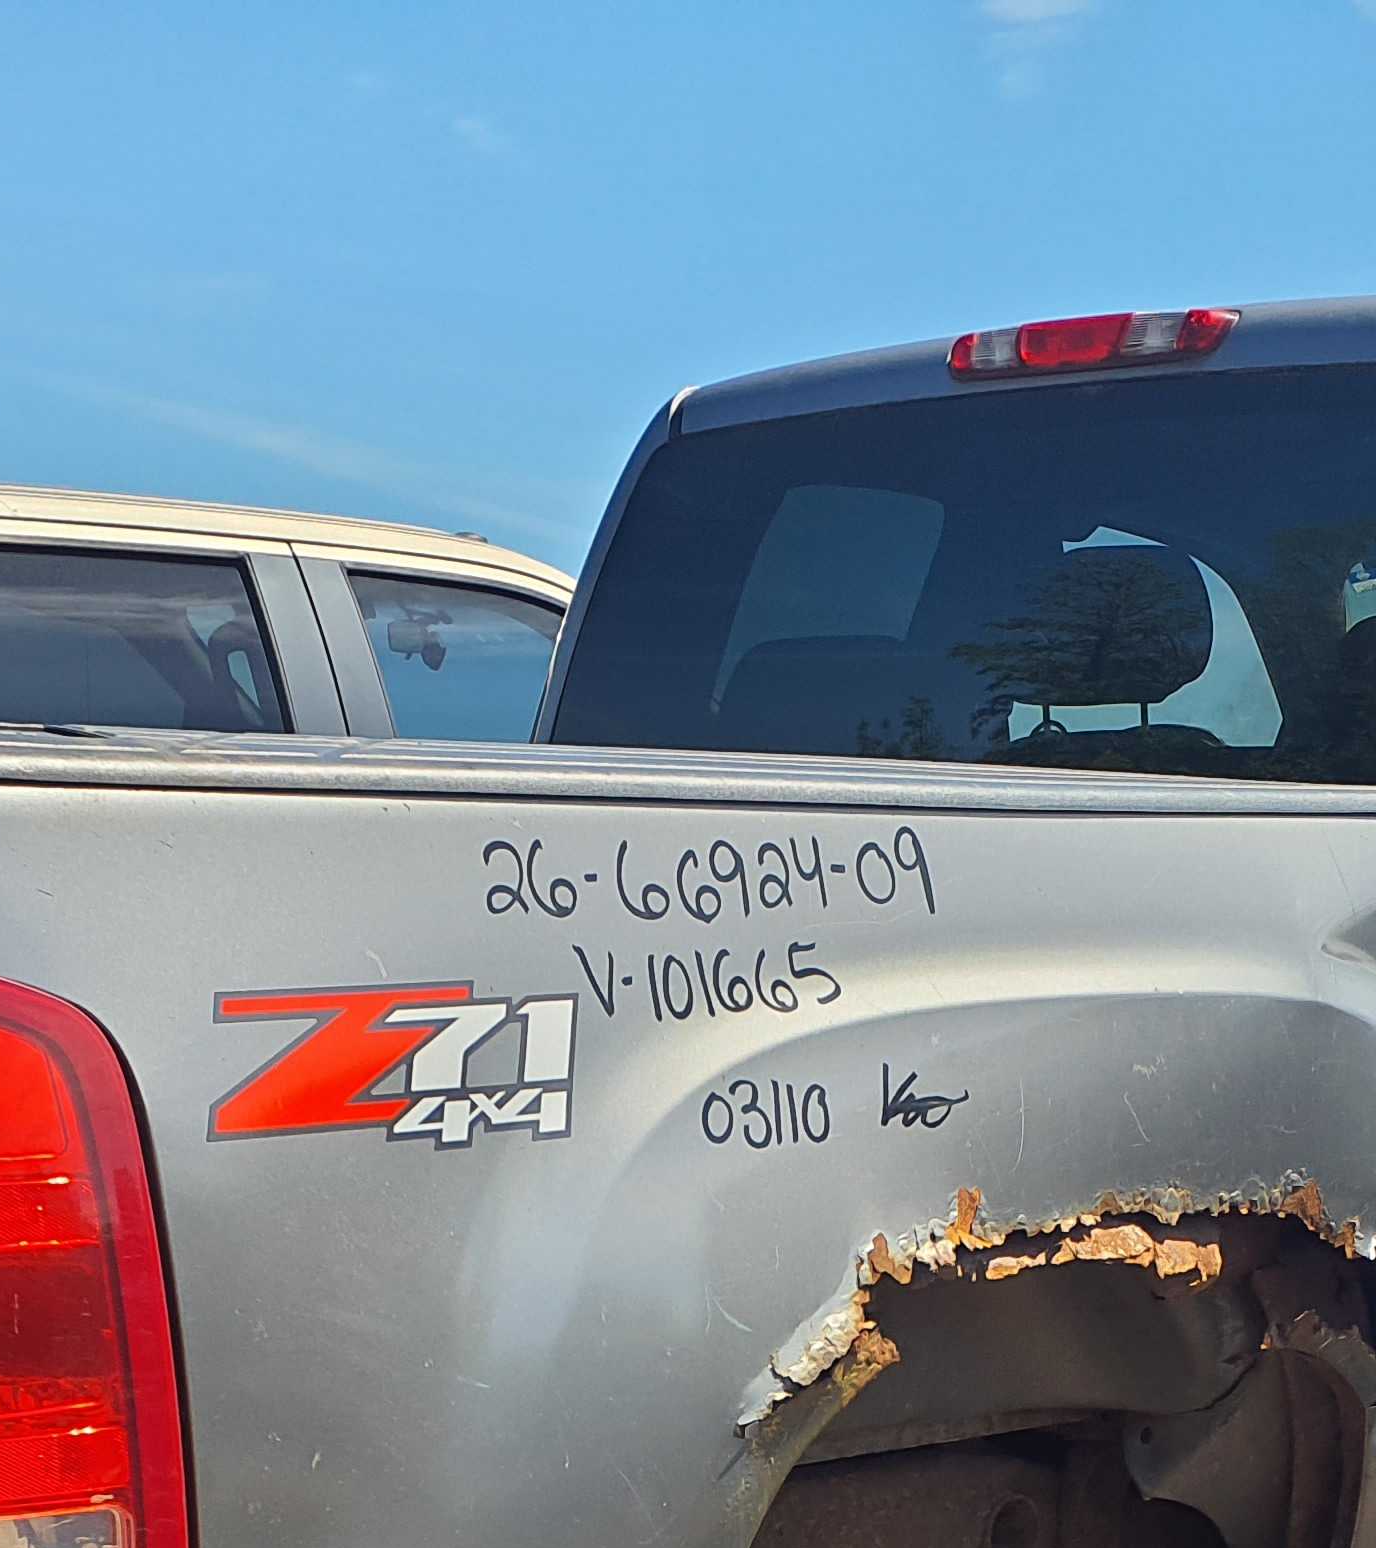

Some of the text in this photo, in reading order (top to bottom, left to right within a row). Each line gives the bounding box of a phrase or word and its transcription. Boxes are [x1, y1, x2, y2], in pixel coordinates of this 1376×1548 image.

[482, 826, 936, 924] 26-66924-09
[572, 941, 842, 1022] V-101665
[211, 983, 577, 1137] Z71
[701, 1079, 830, 1149] 03110
